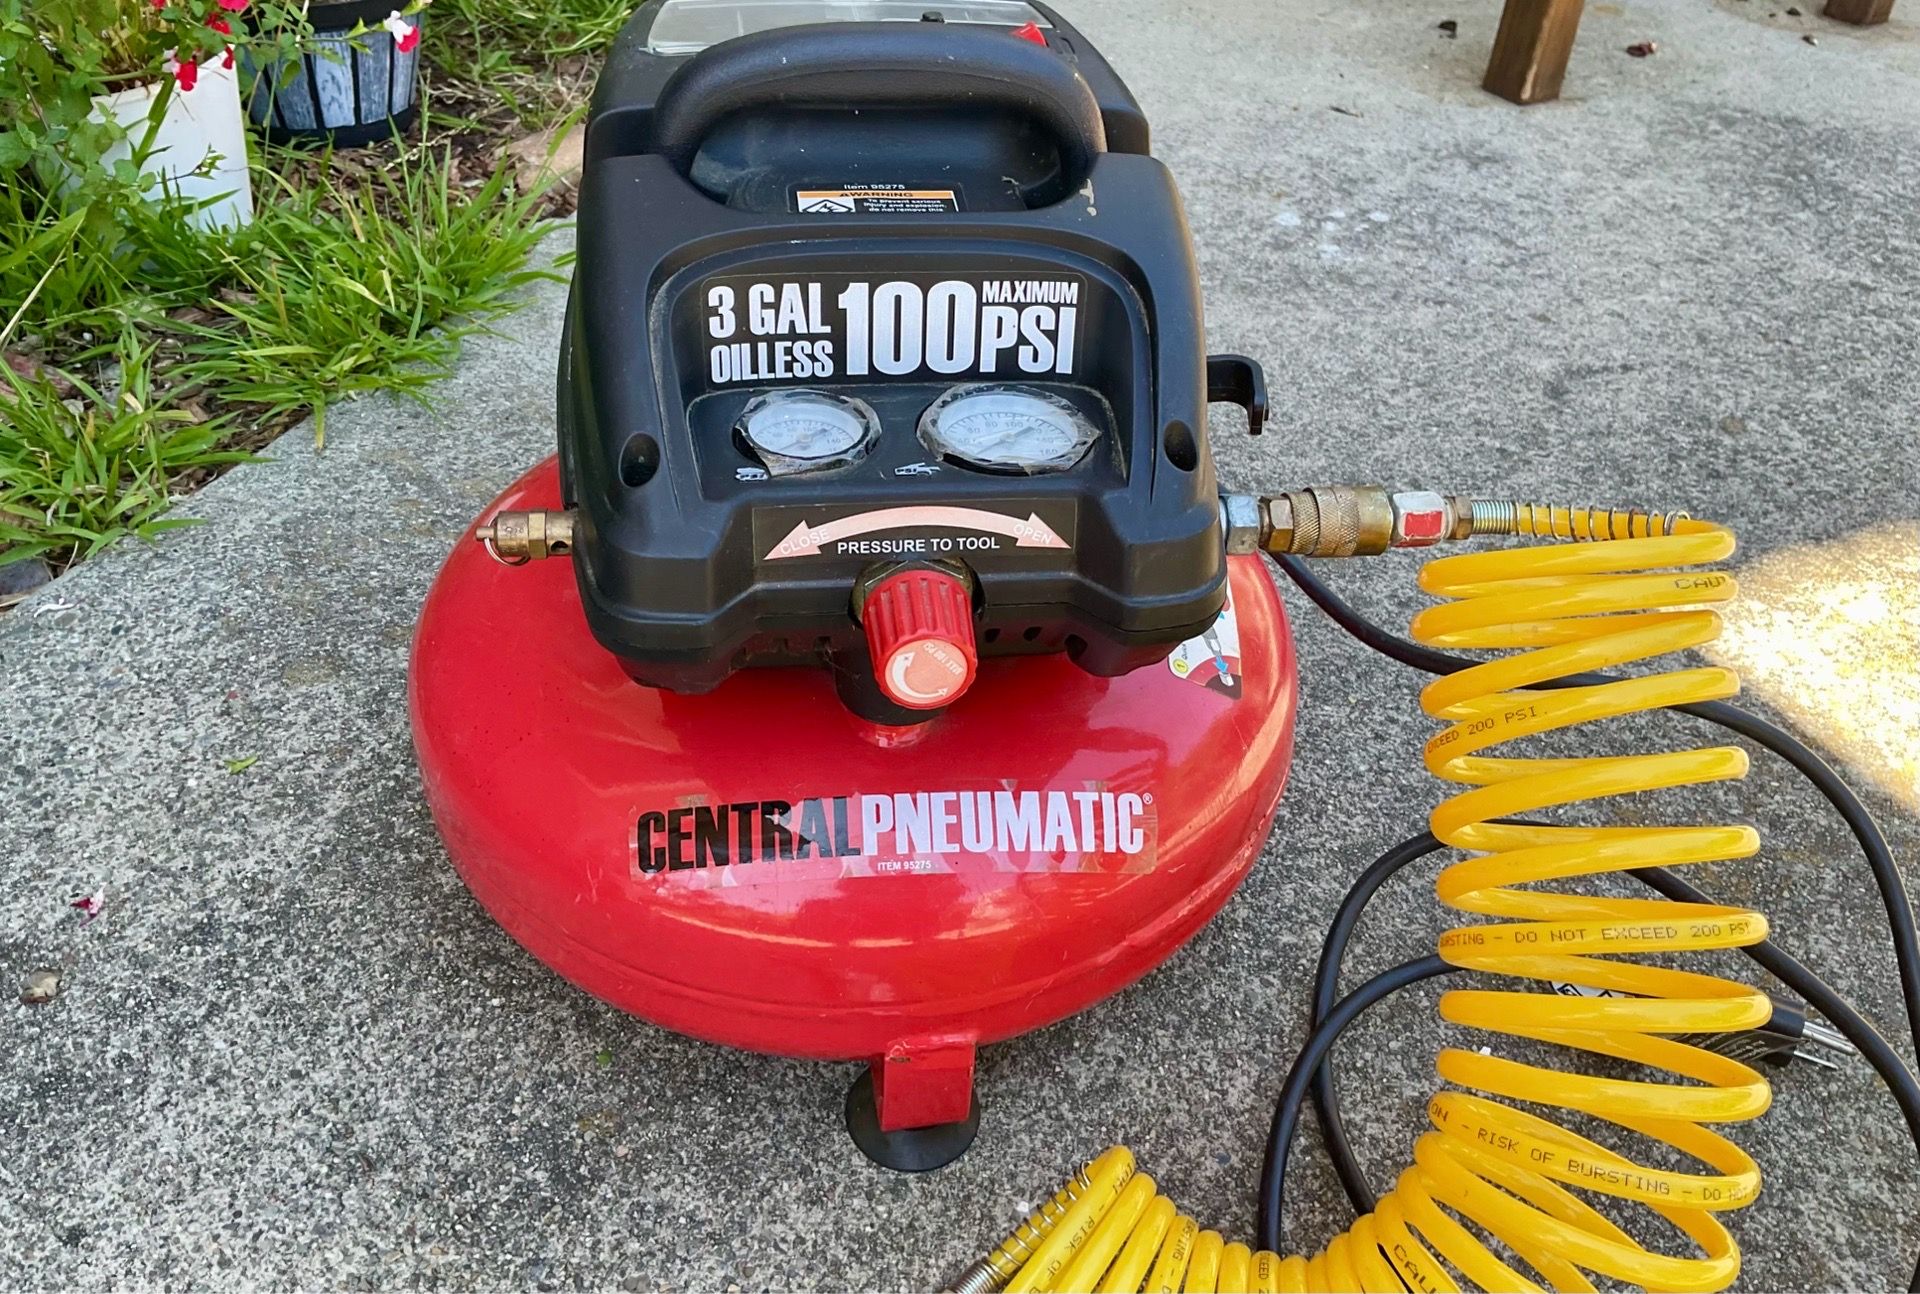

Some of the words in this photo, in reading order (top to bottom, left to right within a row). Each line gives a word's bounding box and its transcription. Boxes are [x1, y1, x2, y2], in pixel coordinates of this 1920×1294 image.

[982, 281, 1078, 304] MAXIMUM
[708, 286, 735, 338] 3
[749, 283, 831, 335] GAL
[838, 281, 977, 375] 100
[979, 305, 1077, 374] PSI
[710, 340, 833, 383] OILLESS
[780, 528, 829, 555] CLOSE
[837, 538, 925, 554] PRESSURE
[930, 538, 952, 551] TO
[955, 537, 1000, 550] TOOL
[1013, 524, 1052, 544] OPEN
[1467, 718, 1494, 735] 200
[876, 861, 902, 871] ITEM
[903, 860, 932, 870] 95275
[1514, 931, 1538, 943] DO
[1550, 929, 1587, 942] NOT
[1601, 926, 1678, 940] EXCEED
[1690, 924, 1722, 938] 200
[1477, 1128, 1520, 1154] RISK
[1530, 1148, 1555, 1163] OF
[1568, 1159, 1670, 1196] BURSTING
[1703, 1188, 1722, 1200] DO
[1064, 1215, 1096, 1254] RISK
[1047, 1259, 1062, 1276] OF
